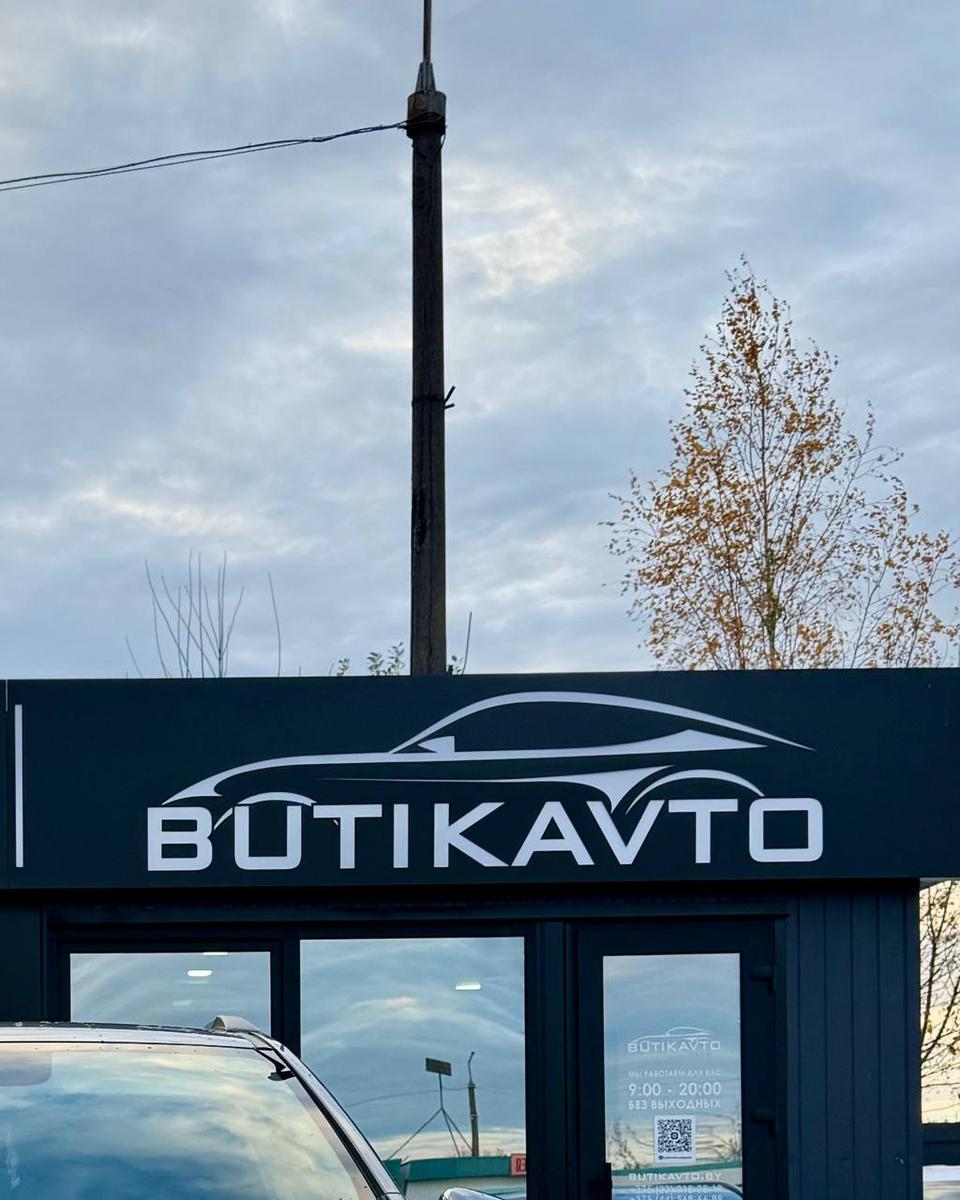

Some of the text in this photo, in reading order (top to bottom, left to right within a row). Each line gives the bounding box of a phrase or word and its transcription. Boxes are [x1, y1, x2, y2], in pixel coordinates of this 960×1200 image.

[147, 797, 824, 872] BUTIKAVTO
[627, 1041, 721, 1053] BUTIKAVTO
[628, 1083, 661, 1097] 9:00
[679, 1081, 722, 1096] 20:00
[628, 1098, 721, 1110] БЕЗ ВЫХОДНЫХ
